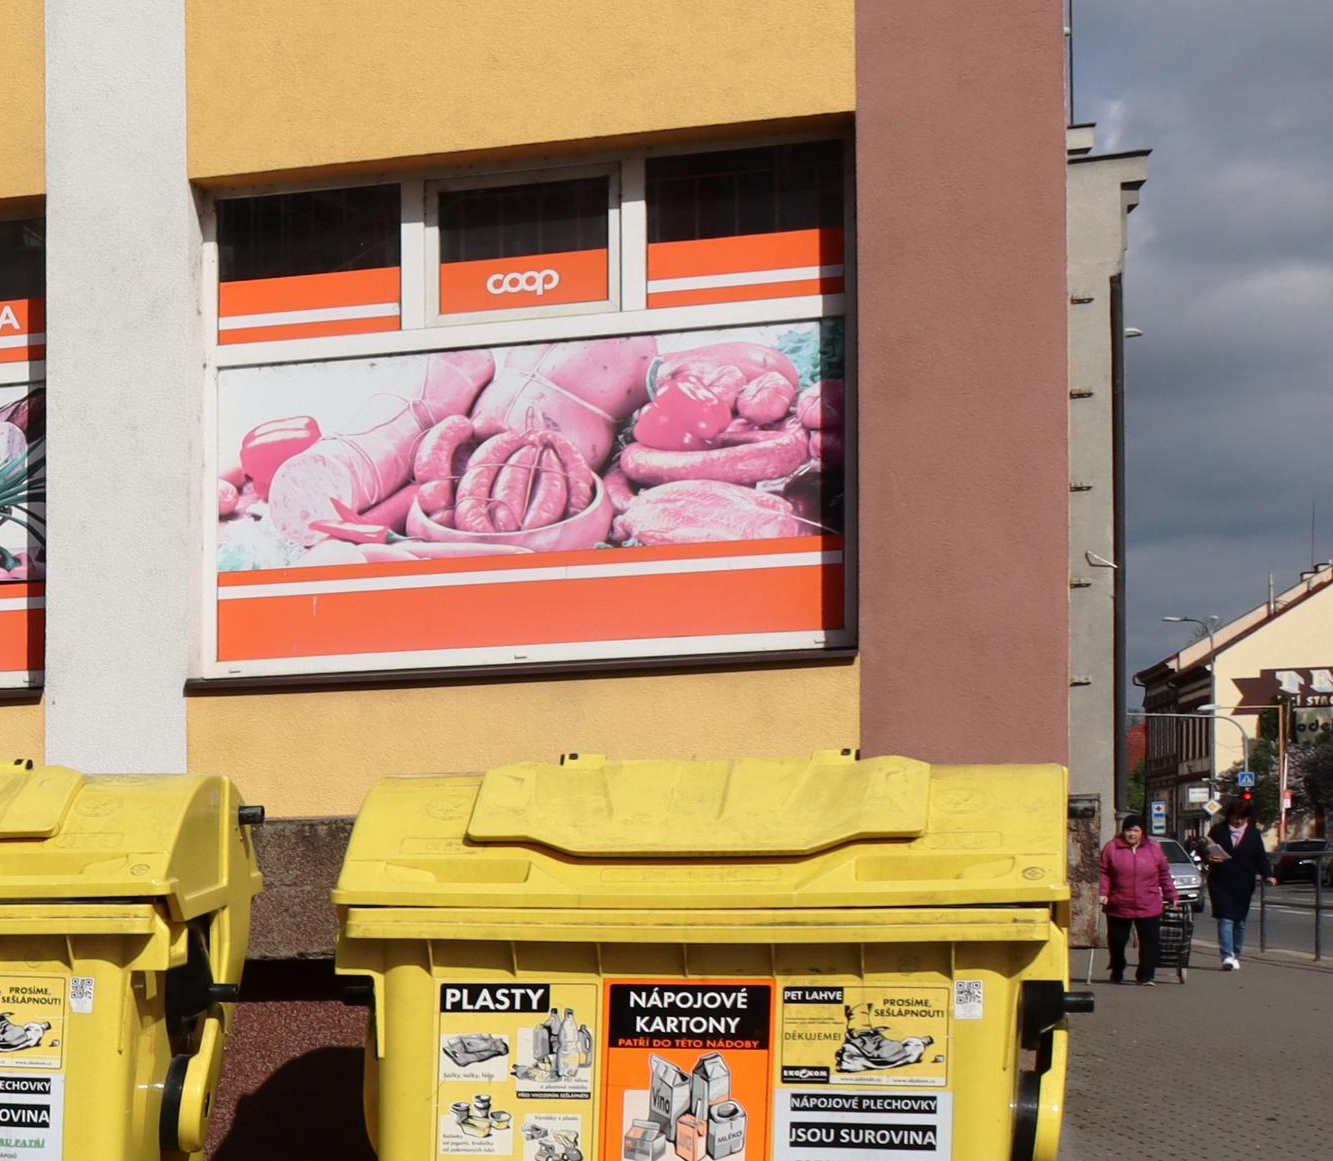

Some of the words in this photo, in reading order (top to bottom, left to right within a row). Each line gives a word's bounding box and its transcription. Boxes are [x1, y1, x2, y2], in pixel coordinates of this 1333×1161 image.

[487, 269, 559, 296] coop
[9, 986, 51, 996] PROSÍME,
[629, 987, 748, 1009] NÁPOJOVÉ
[784, 991, 803, 1000] PET
[805, 991, 842, 1001] LAHVE
[446, 988, 545, 1010] PLASTY
[883, 998, 932, 1008] PROSÍME,
[636, 1016, 740, 1034] KARTONY
[784, 1030, 841, 1041] DĚKUJEME!
[618, 1037, 650, 1047] PATŘÍ
[653, 1039, 671, 1047] DO
[675, 1037, 703, 1048] TÉTO
[706, 1038, 759, 1049] NÁDOBY
[790, 1095, 859, 1109] NÁPOJOVÉ
[862, 1099, 936, 1110] PLECHOVKY
[717, 1130, 743, 1144] MLÉKO
[789, 1128, 835, 1143] JSOU
[839, 1129, 936, 1145] SUROVINA
